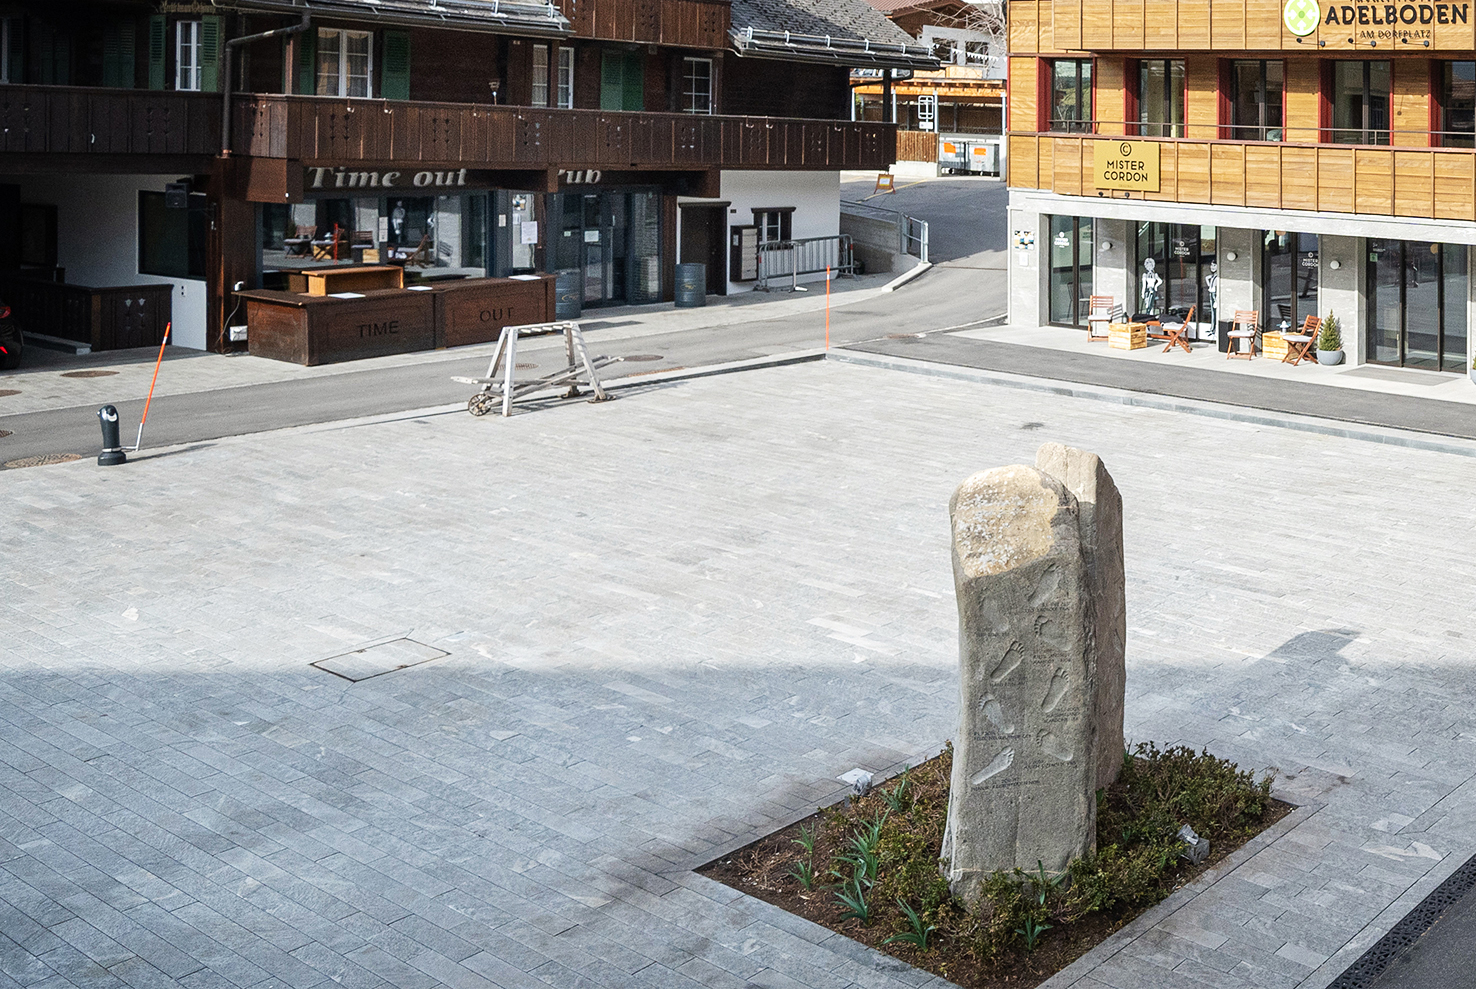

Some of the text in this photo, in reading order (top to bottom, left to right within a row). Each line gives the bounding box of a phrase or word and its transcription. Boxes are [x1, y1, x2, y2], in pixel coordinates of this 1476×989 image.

[1324, 3, 1469, 25] ADELBODEN
[1360, 29, 1431, 39] AM DORFPLATZ
[1106, 160, 1145, 171] MISTER
[308, 166, 602, 189] Time out ub
[1103, 170, 1148, 182] CORDON
[479, 307, 514, 322] OUT
[357, 320, 400, 338] TIME
